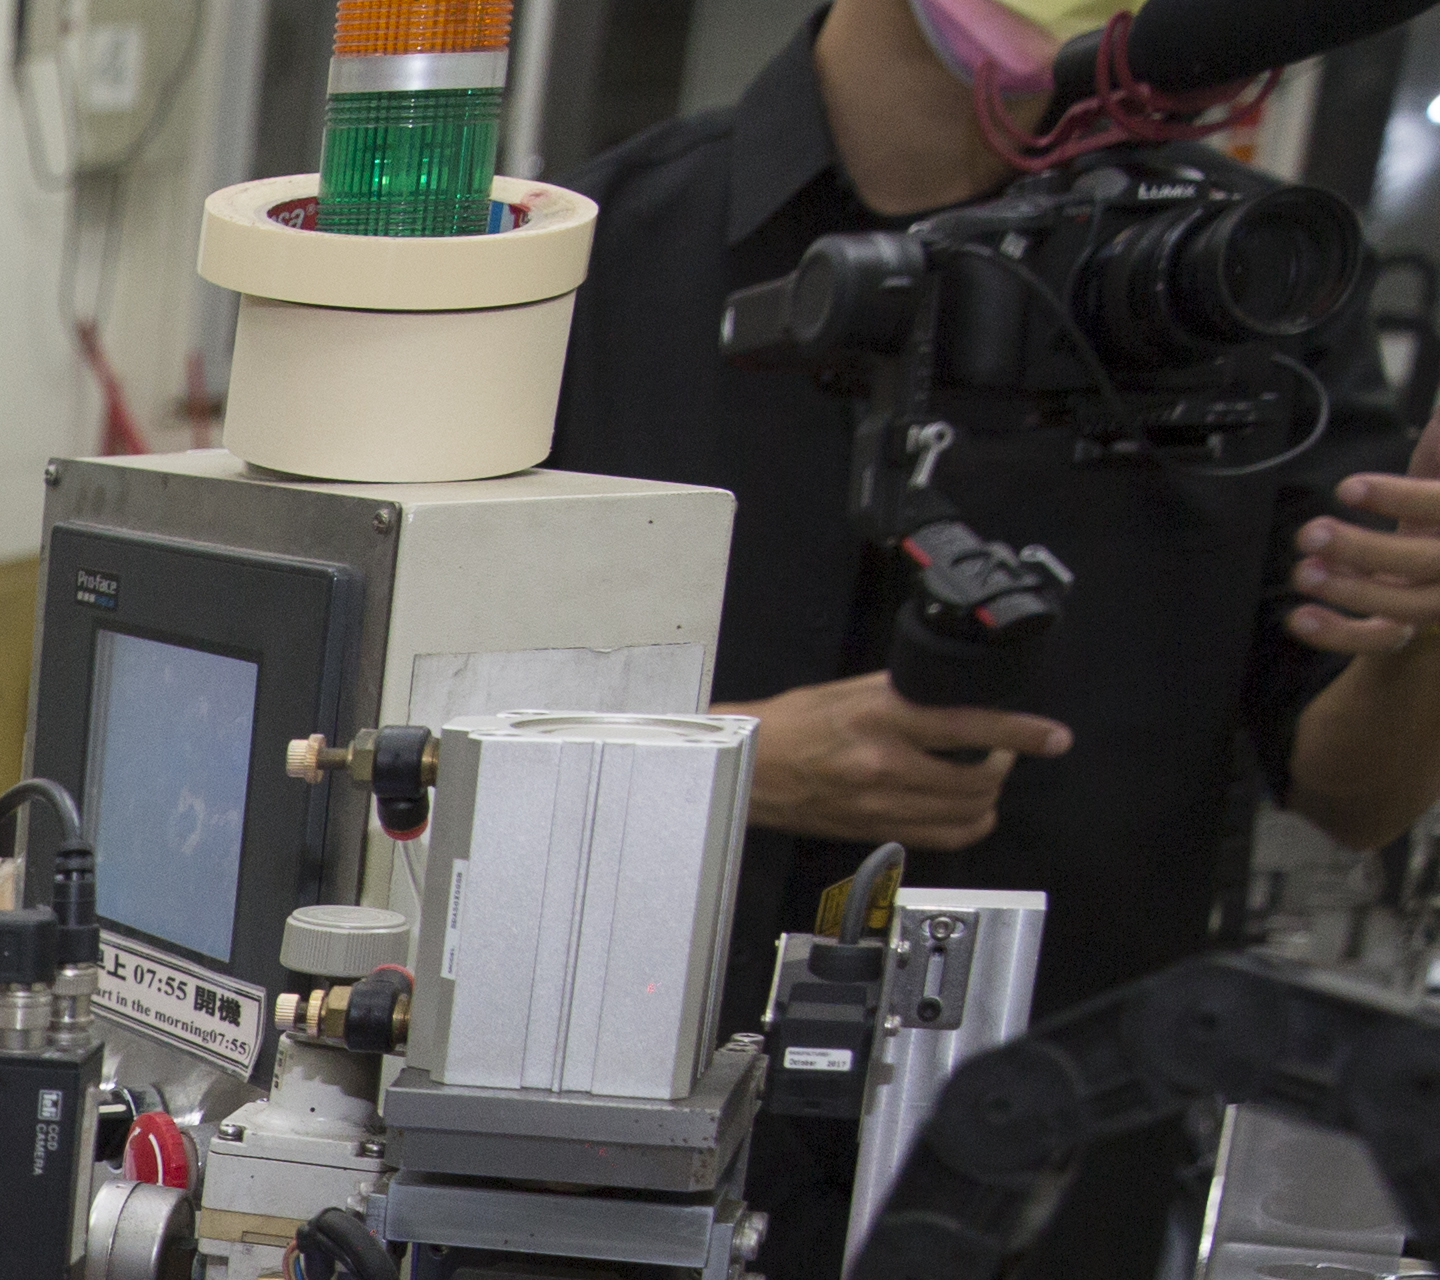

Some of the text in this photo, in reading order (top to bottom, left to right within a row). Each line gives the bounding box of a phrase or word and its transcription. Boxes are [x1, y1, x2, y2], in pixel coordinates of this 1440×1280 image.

[116, 991, 128, 1008] in
[131, 998, 150, 1017] the
[133, 963, 188, 1001] 07:55
[193, 984, 242, 1028] 開機
[33, 1123, 47, 1176] CAMERA
[46, 1124, 59, 1151] CCD
